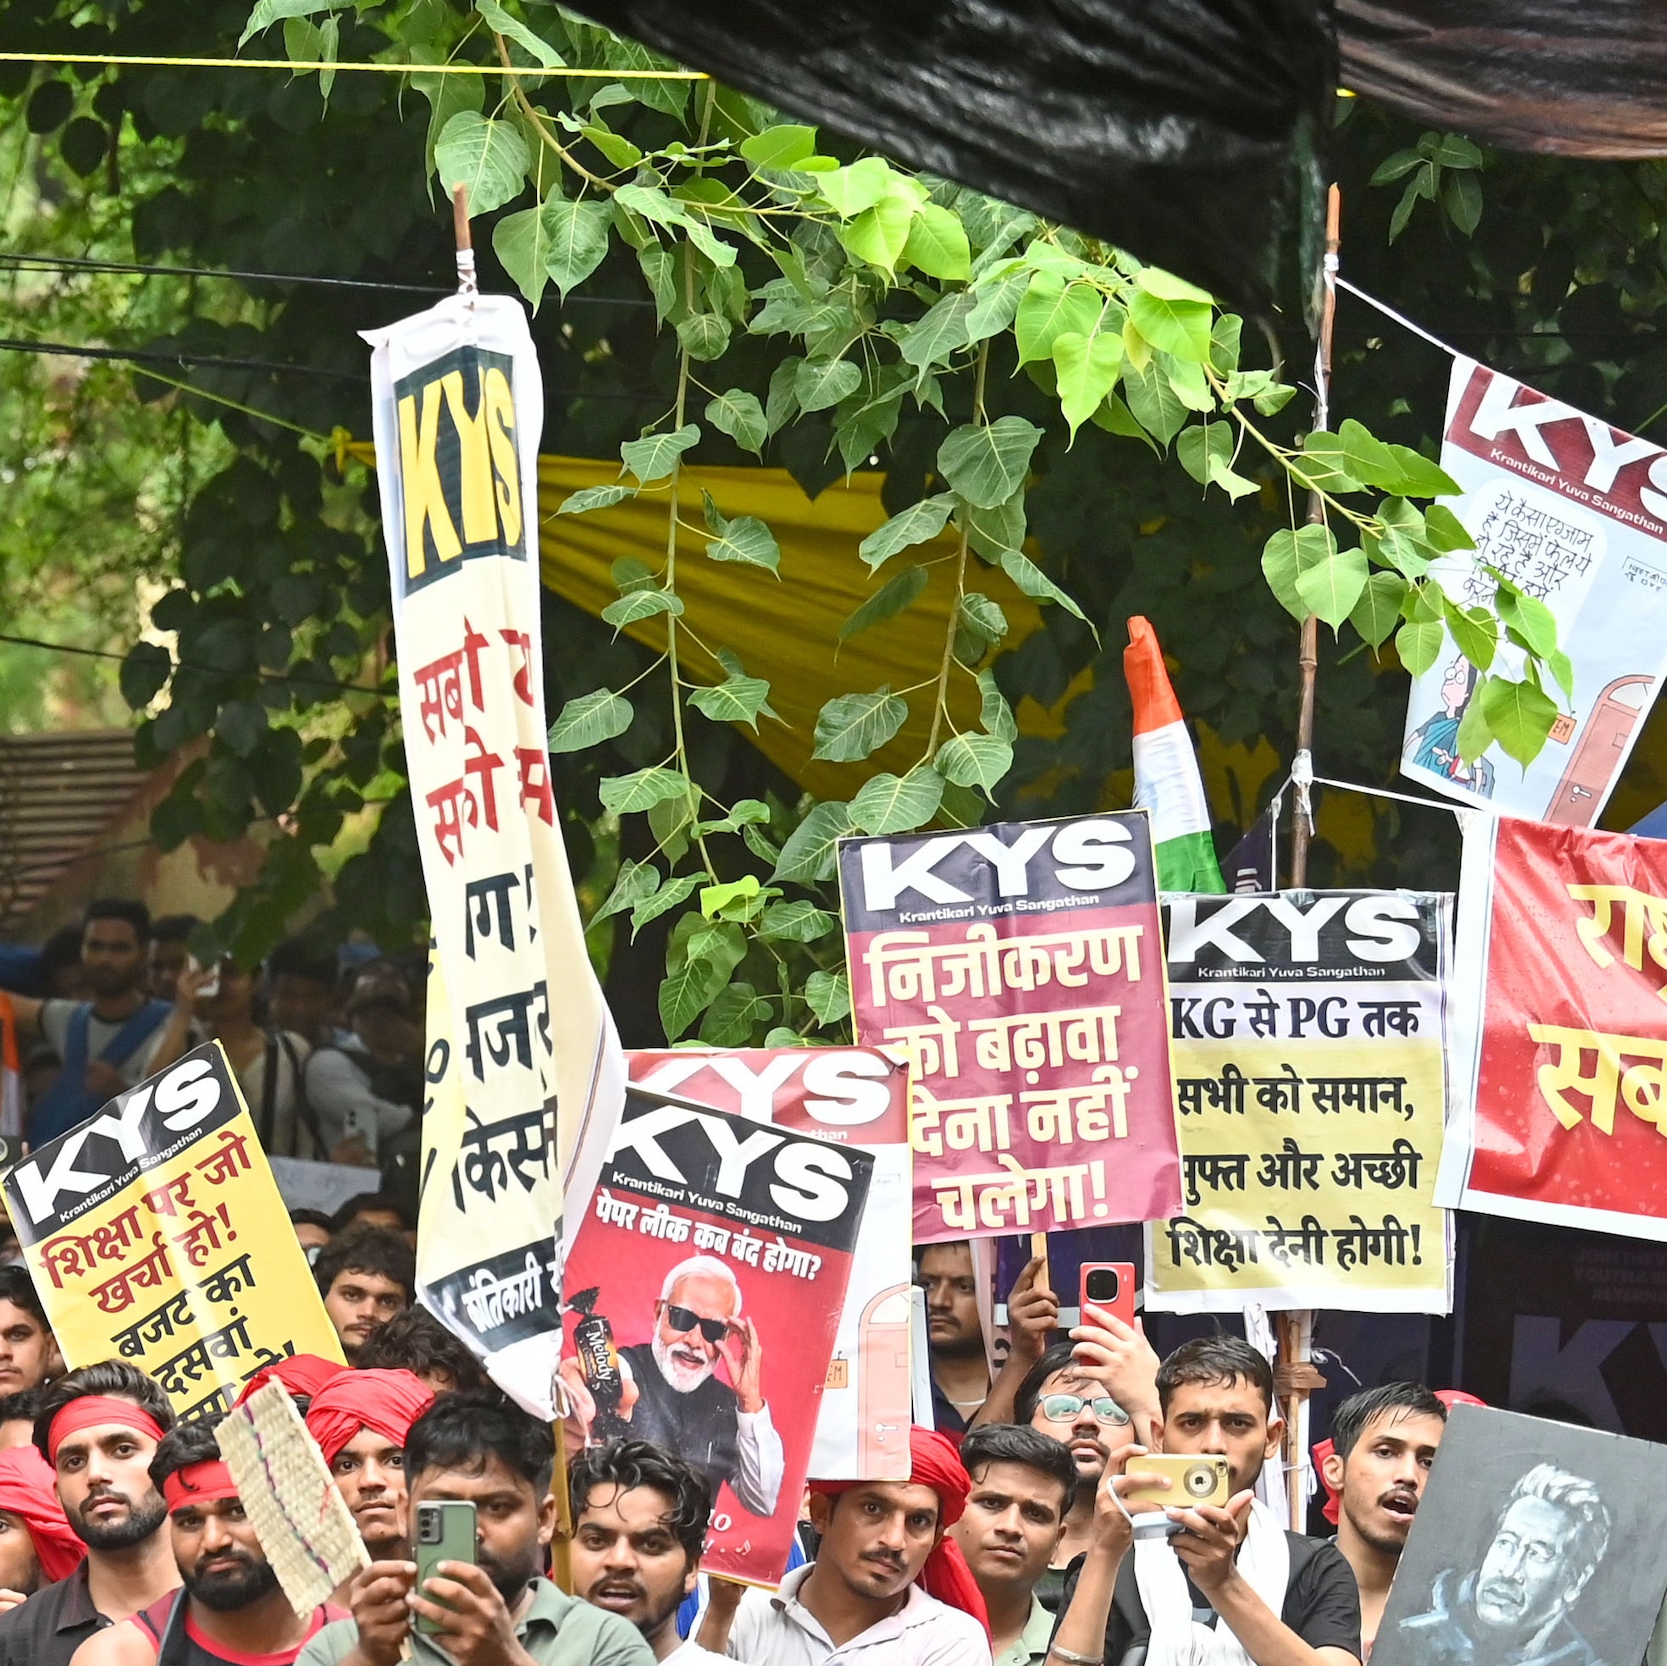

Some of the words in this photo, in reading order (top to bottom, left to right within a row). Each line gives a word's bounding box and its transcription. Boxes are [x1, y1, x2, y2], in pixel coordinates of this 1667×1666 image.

[398, 365, 523, 579] KYS
[1489, 447, 1555, 490] Krantikari
[1557, 479, 1589, 503] Yuva
[1591, 492, 1663, 535] Sangathan
[860, 819, 1136, 912] KYS
[899, 905, 974, 924] Krantikari
[977, 902, 1013, 917] Yuva
[1016, 893, 1100, 916] Sangathan
[863, 923, 1145, 1007] निजीकरण
[1169, 898, 1421, 963] KYS
[1198, 966, 1267, 979] Krantikari
[1269, 966, 1305, 978] Yuva
[1307, 966, 1385, 980] Sangathan
[884, 1006, 961, 1081] को
[968, 1005, 1122, 1085] बढ़ावा
[1170, 997, 1236, 1040] KG
[1244, 988, 1280, 1038] से
[1288, 997, 1350, 1040] PG
[1358, 1001, 1421, 1038] तक
[912, 1091, 1013, 1157] देना
[1020, 1065, 1140, 1145] नहीं
[1176, 1063, 1250, 1115] सभी
[1253, 1063, 1307, 1115] को
[1307, 1076, 1414, 1122] समान,
[13, 1058, 222, 1225] KYS
[59, 1183, 115, 1223] Krantikari
[115, 1164, 140, 1188] Yuva
[139, 1126, 203, 1170] Sangathan
[605, 1104, 854, 1223] KYS
[1256, 1137, 1324, 1192] और
[1330, 1137, 1423, 1189] अच्छी
[38, 1204, 143, 1290] शिक्षा
[140, 1172, 196, 1218] पर
[195, 1130, 252, 1186] जो
[596, 1189, 635, 1231] पेपर
[640, 1202, 693, 1245] लीक
[695, 1220, 730, 1256] कब
[732, 1228, 760, 1266] बंद
[763, 1240, 822, 1282] होगा?
[612, 1170, 685, 1202] Krantikari
[687, 1191, 725, 1213] Yuva
[725, 1201, 803, 1235] Sangathan
[930, 1154, 1110, 1231] चलेगा!
[88, 1231, 173, 1314] खर्चा
[173, 1202, 238, 1267] हो!
[1166, 1215, 1260, 1273] शिक्षा
[1263, 1215, 1330, 1268] देनी
[1332, 1215, 1421, 1270] होगी!
[110, 1288, 197, 1359] बजट
[196, 1253, 257, 1304] का
[150, 1306, 254, 1395] दसवां
[586, 1329, 612, 1383] Melody
